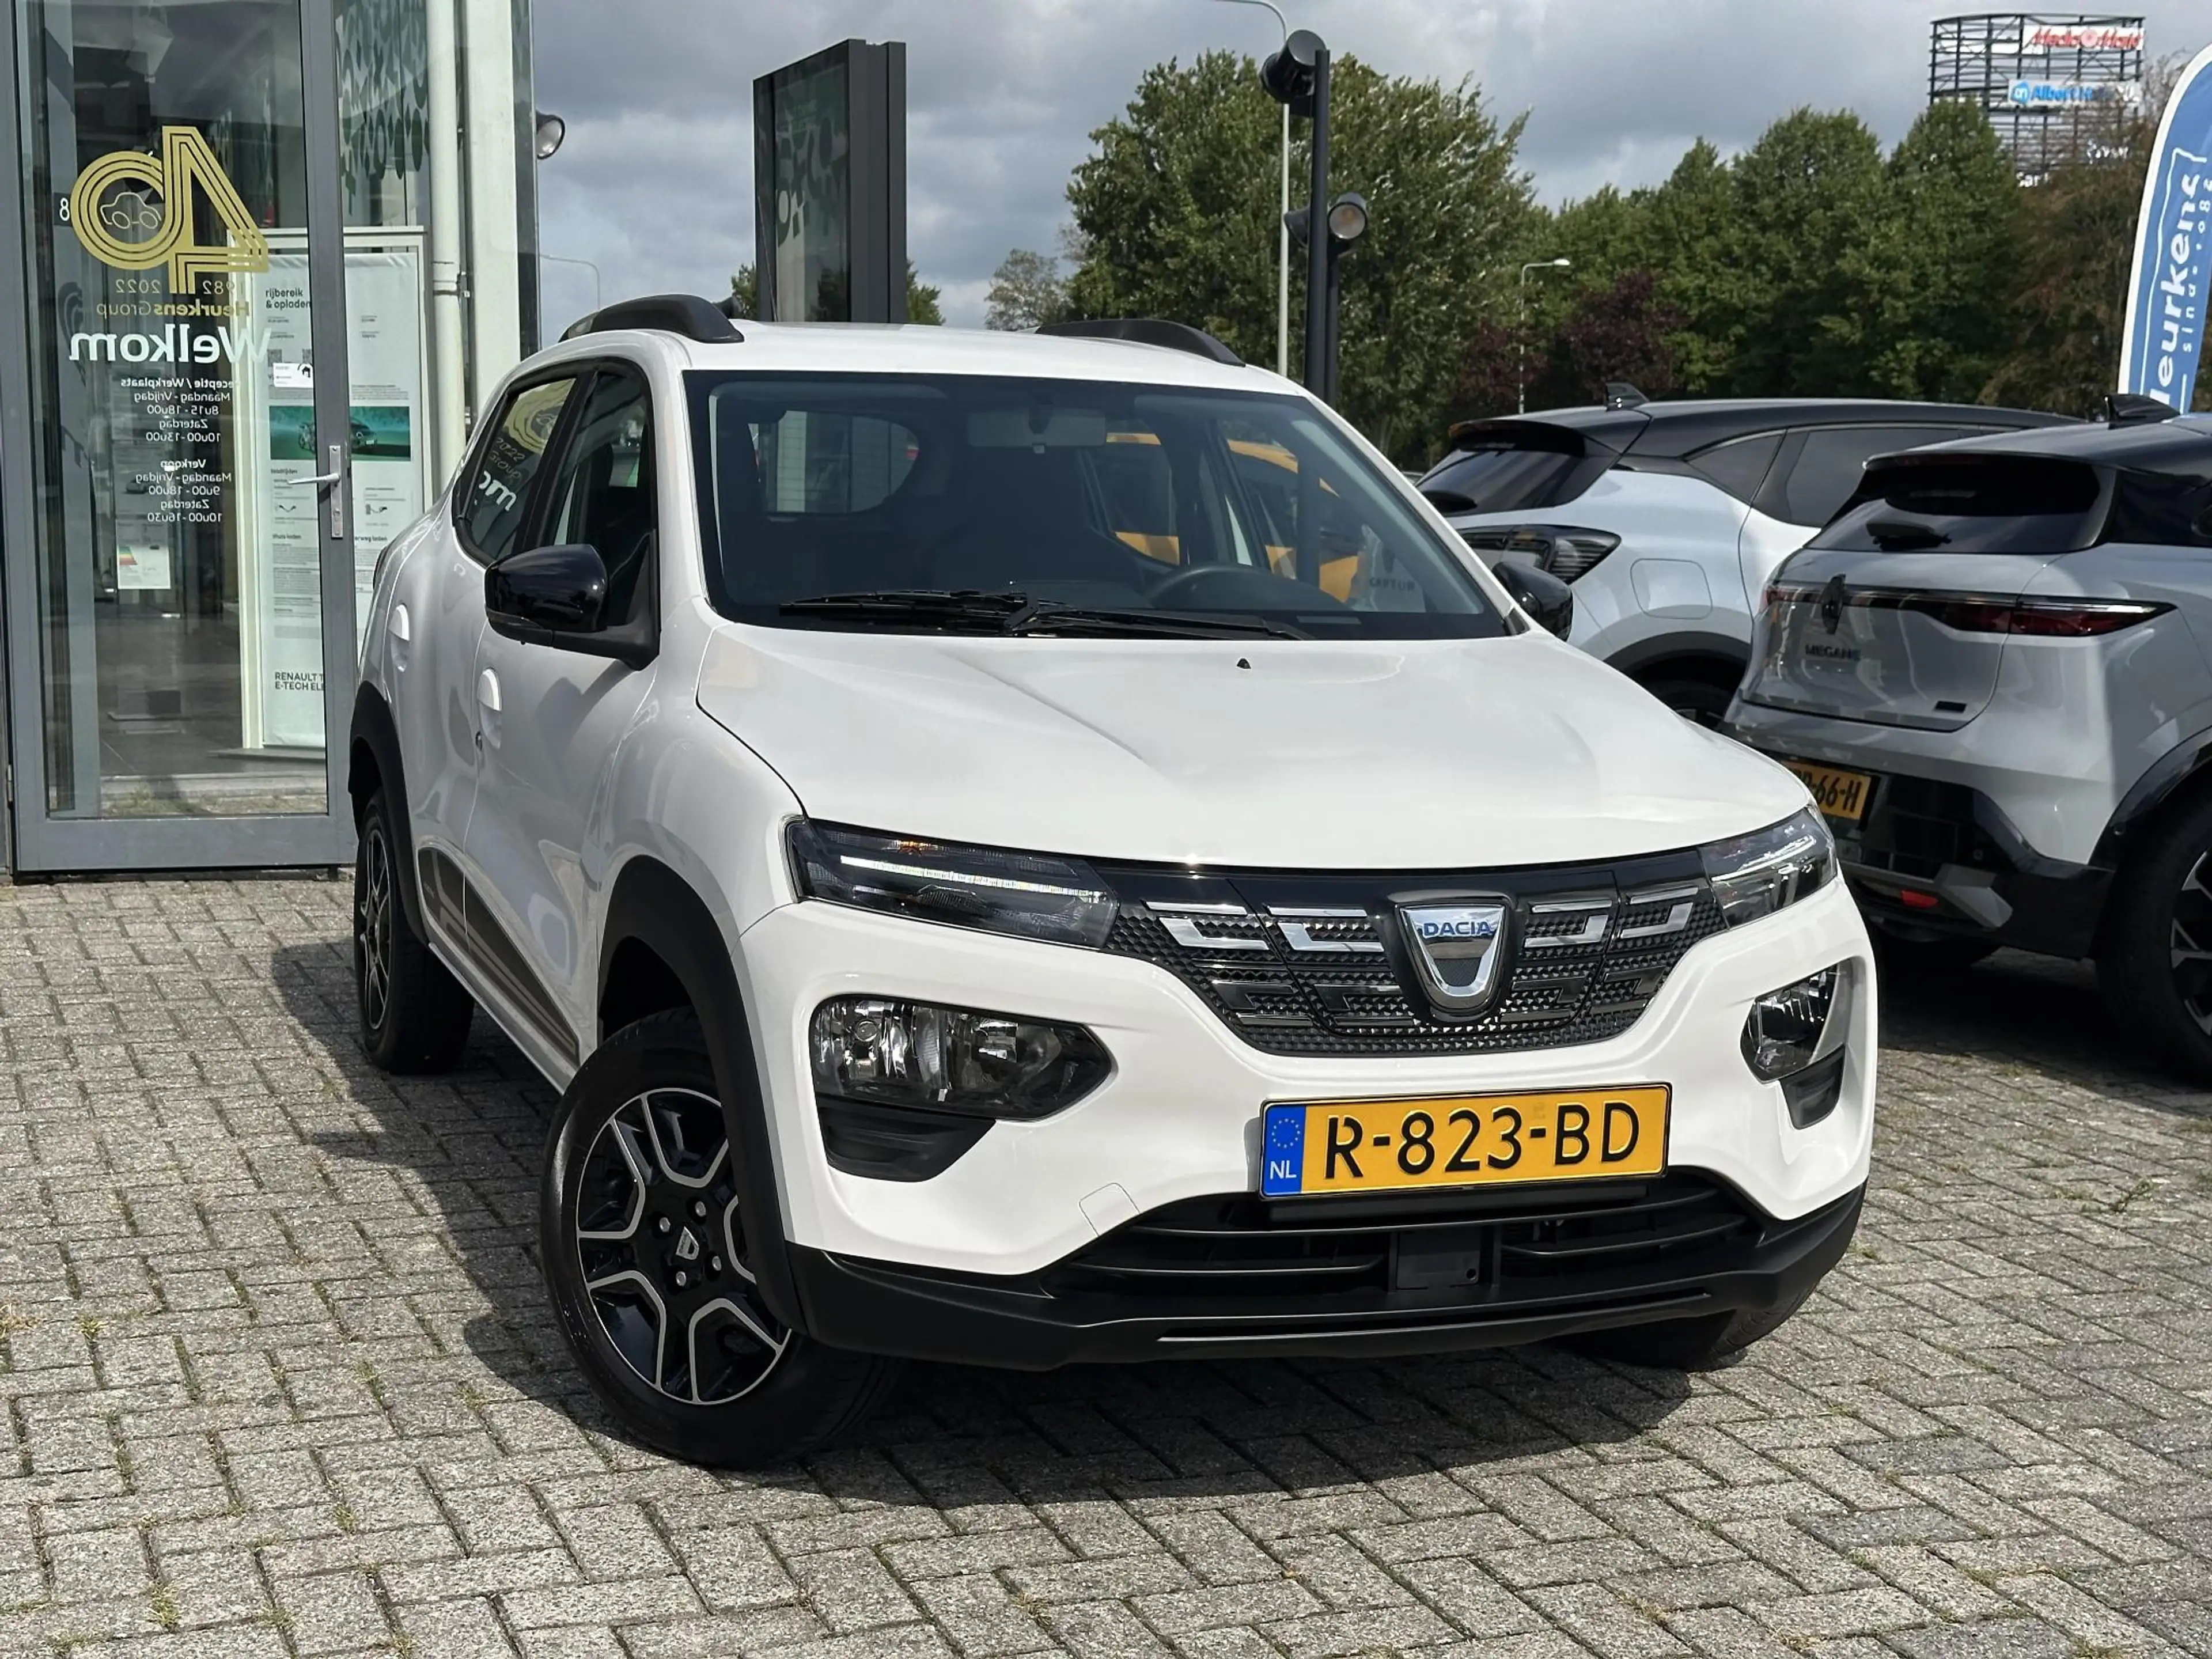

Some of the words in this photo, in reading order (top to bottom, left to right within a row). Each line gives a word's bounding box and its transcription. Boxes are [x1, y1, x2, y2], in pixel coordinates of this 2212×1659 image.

[59, 198, 70, 221] 8
[266, 300, 272, 309] &
[275, 672, 317, 681] RENAULT
[1423, 921, 1491, 936] DACIA
[1324, 1100, 1640, 1180] R-823-BD
[1269, 1160, 1297, 1180] NL
